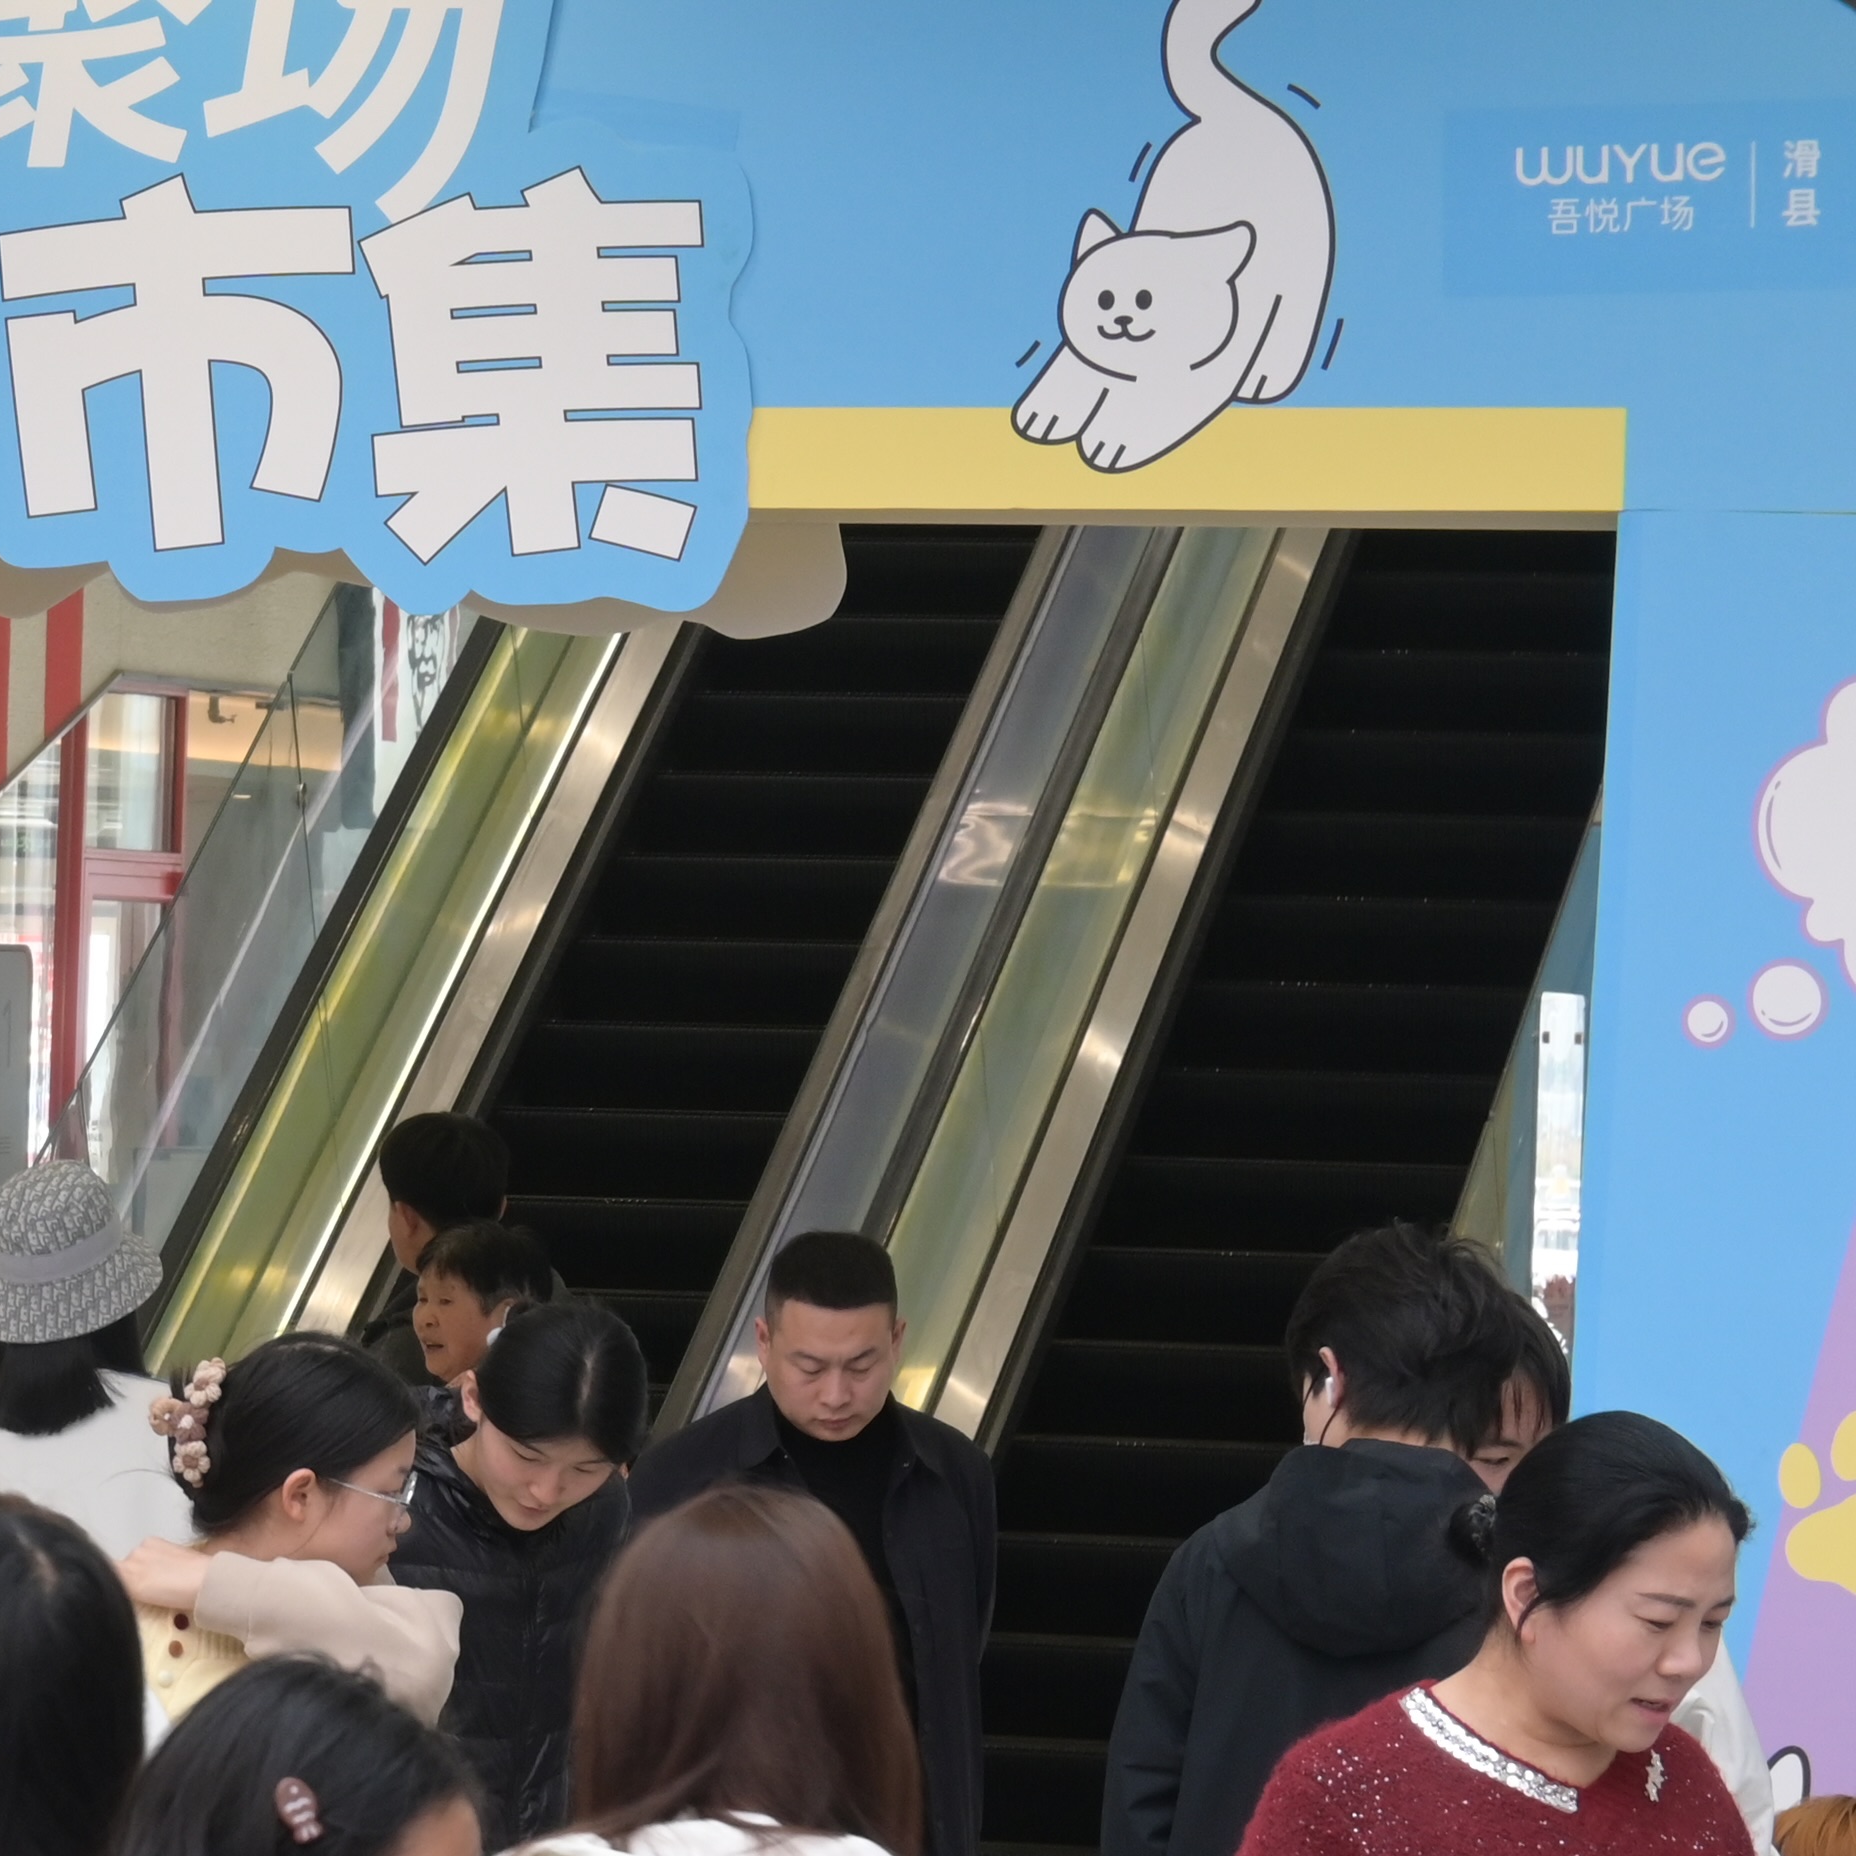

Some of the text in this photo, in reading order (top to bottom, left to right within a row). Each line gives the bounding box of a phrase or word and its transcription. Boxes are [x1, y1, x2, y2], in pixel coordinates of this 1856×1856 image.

[1547, 195, 1694, 235] 吾悦广场
[1781, 139, 1821, 228] 滑县
